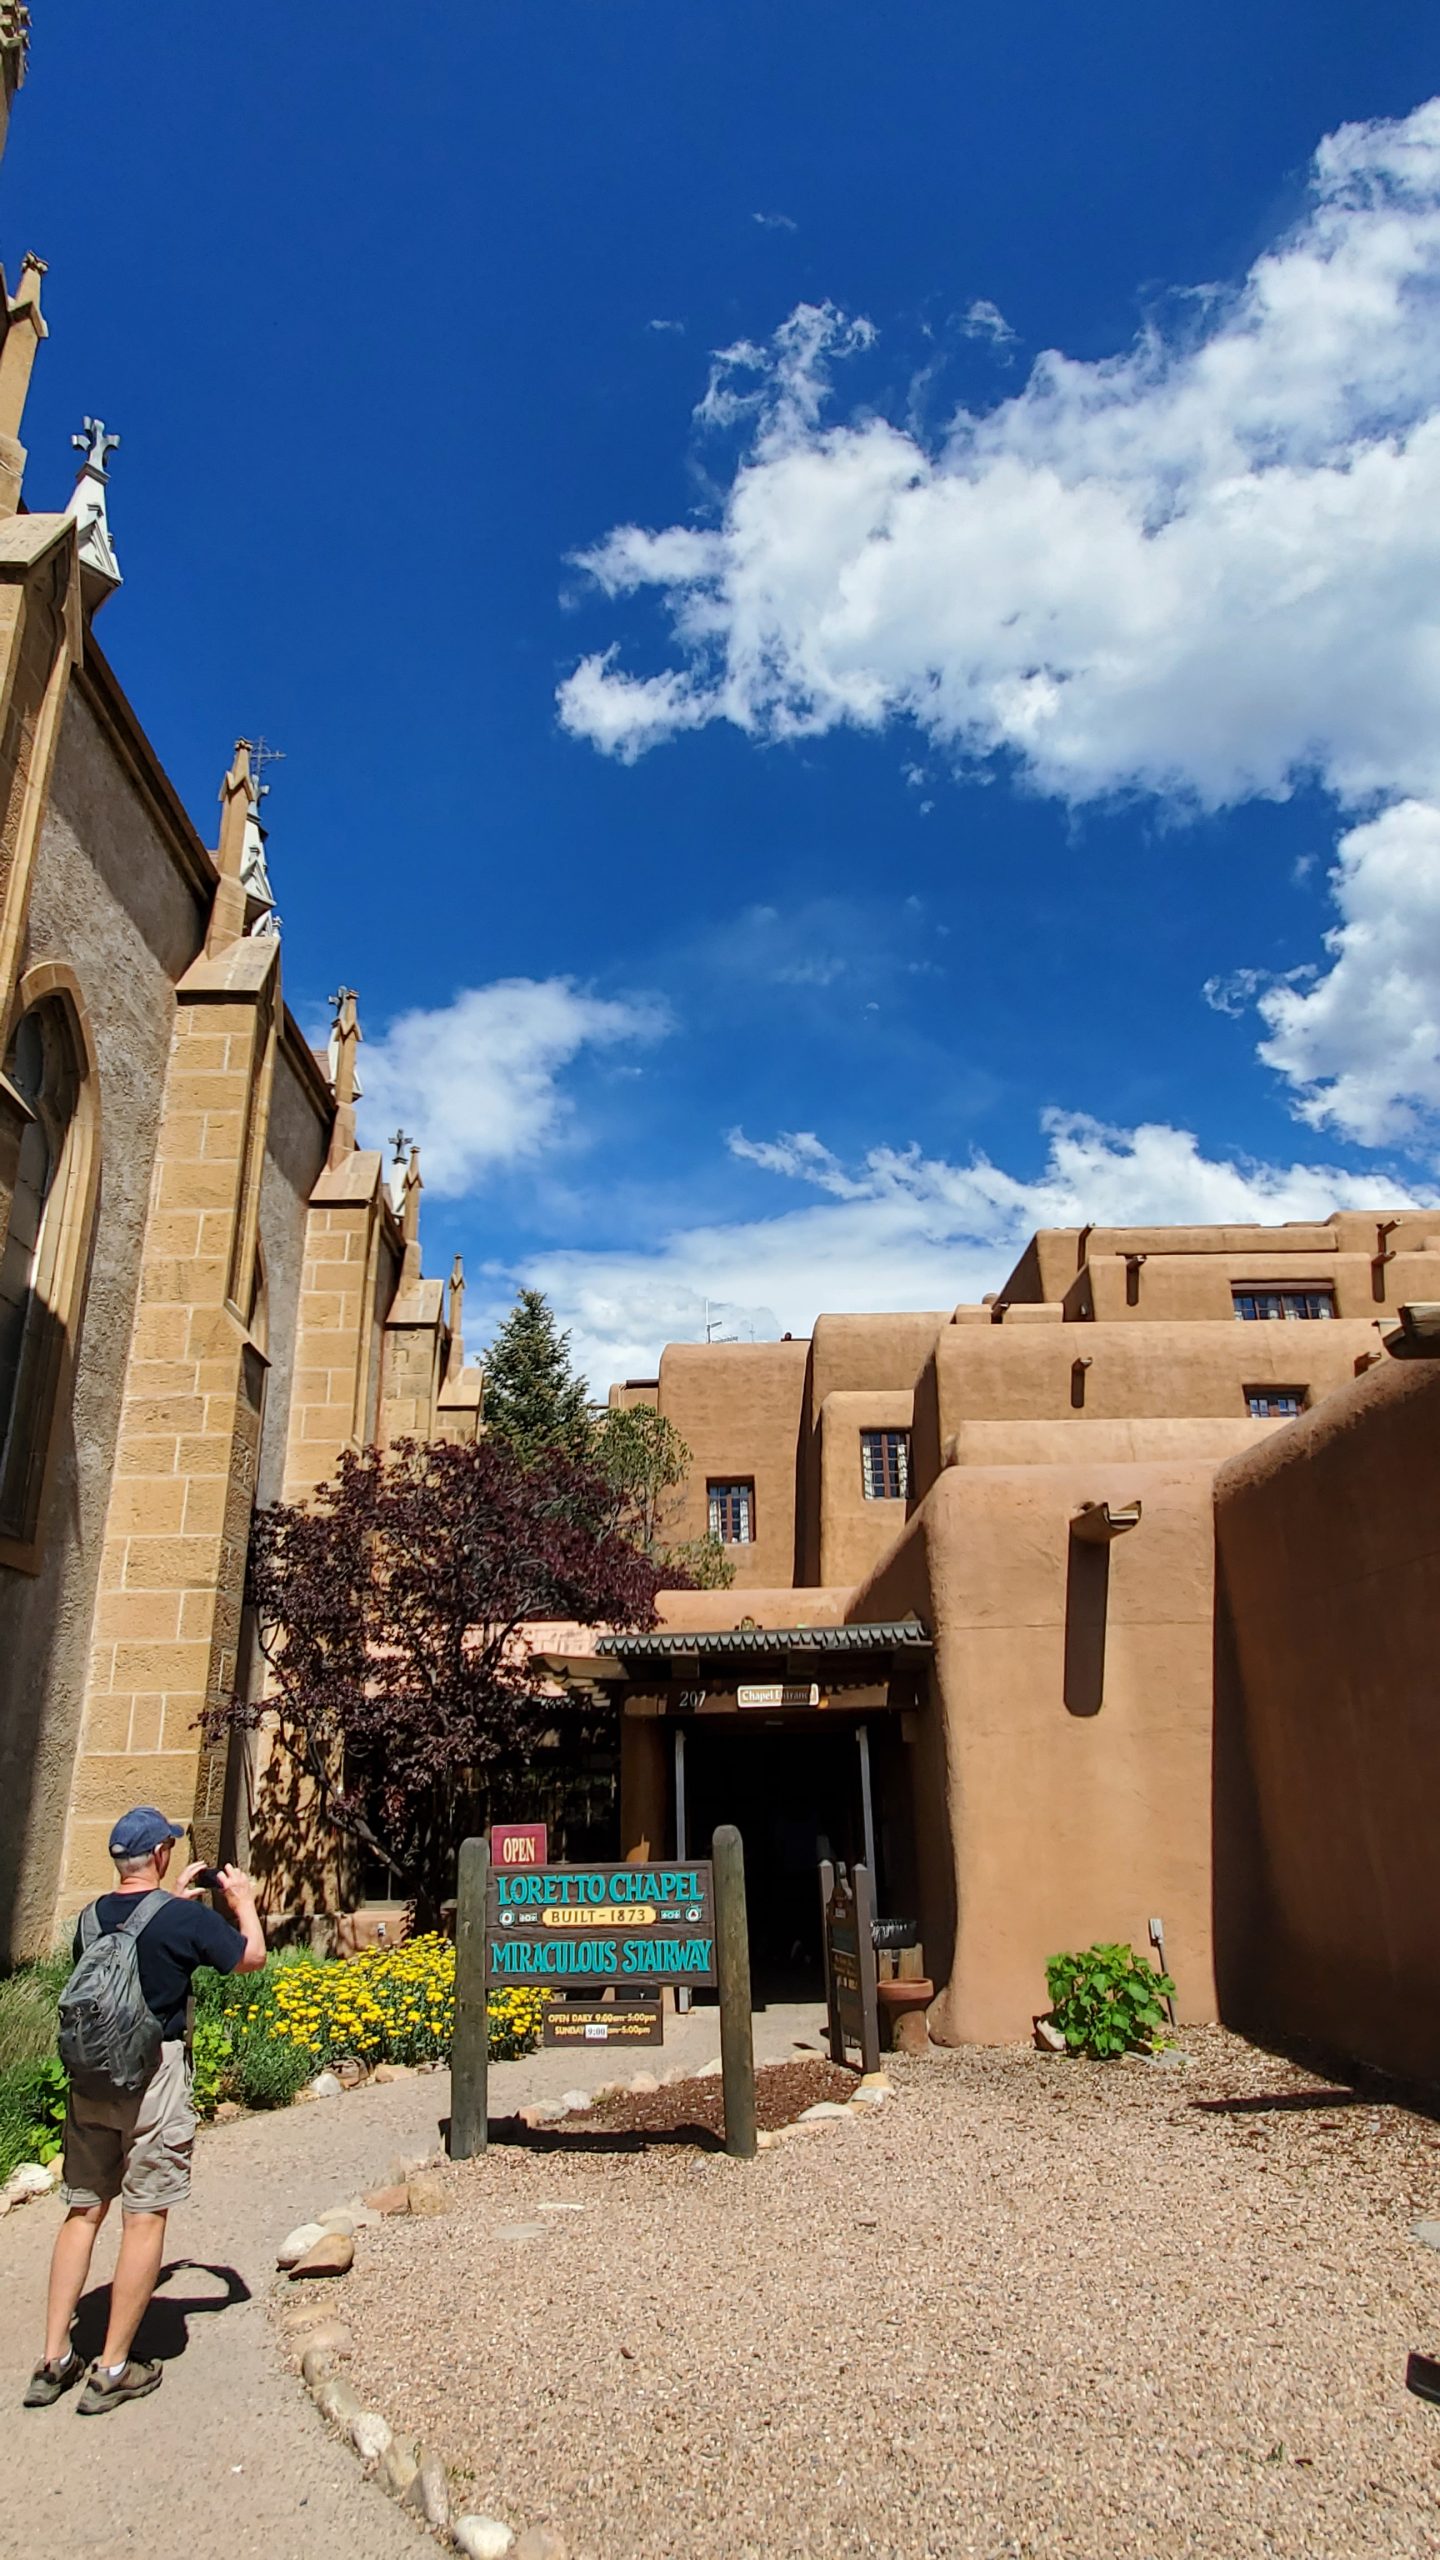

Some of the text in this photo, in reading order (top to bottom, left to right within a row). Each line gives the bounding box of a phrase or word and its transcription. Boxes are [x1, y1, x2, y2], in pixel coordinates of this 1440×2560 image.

[679, 1690, 707, 1707] 207
[742, 1689, 773, 1702] Chapel
[503, 1838, 535, 1863] OPEN
[497, 1872, 704, 1906] LORETTO CHAPEL
[491, 1939, 712, 1974] MIRACULOUS STAIRWAY
[548, 2014, 570, 2023] OPEN
[572, 2014, 593, 2023] DAILY
[555, 2026, 584, 2035] SUNDAY
